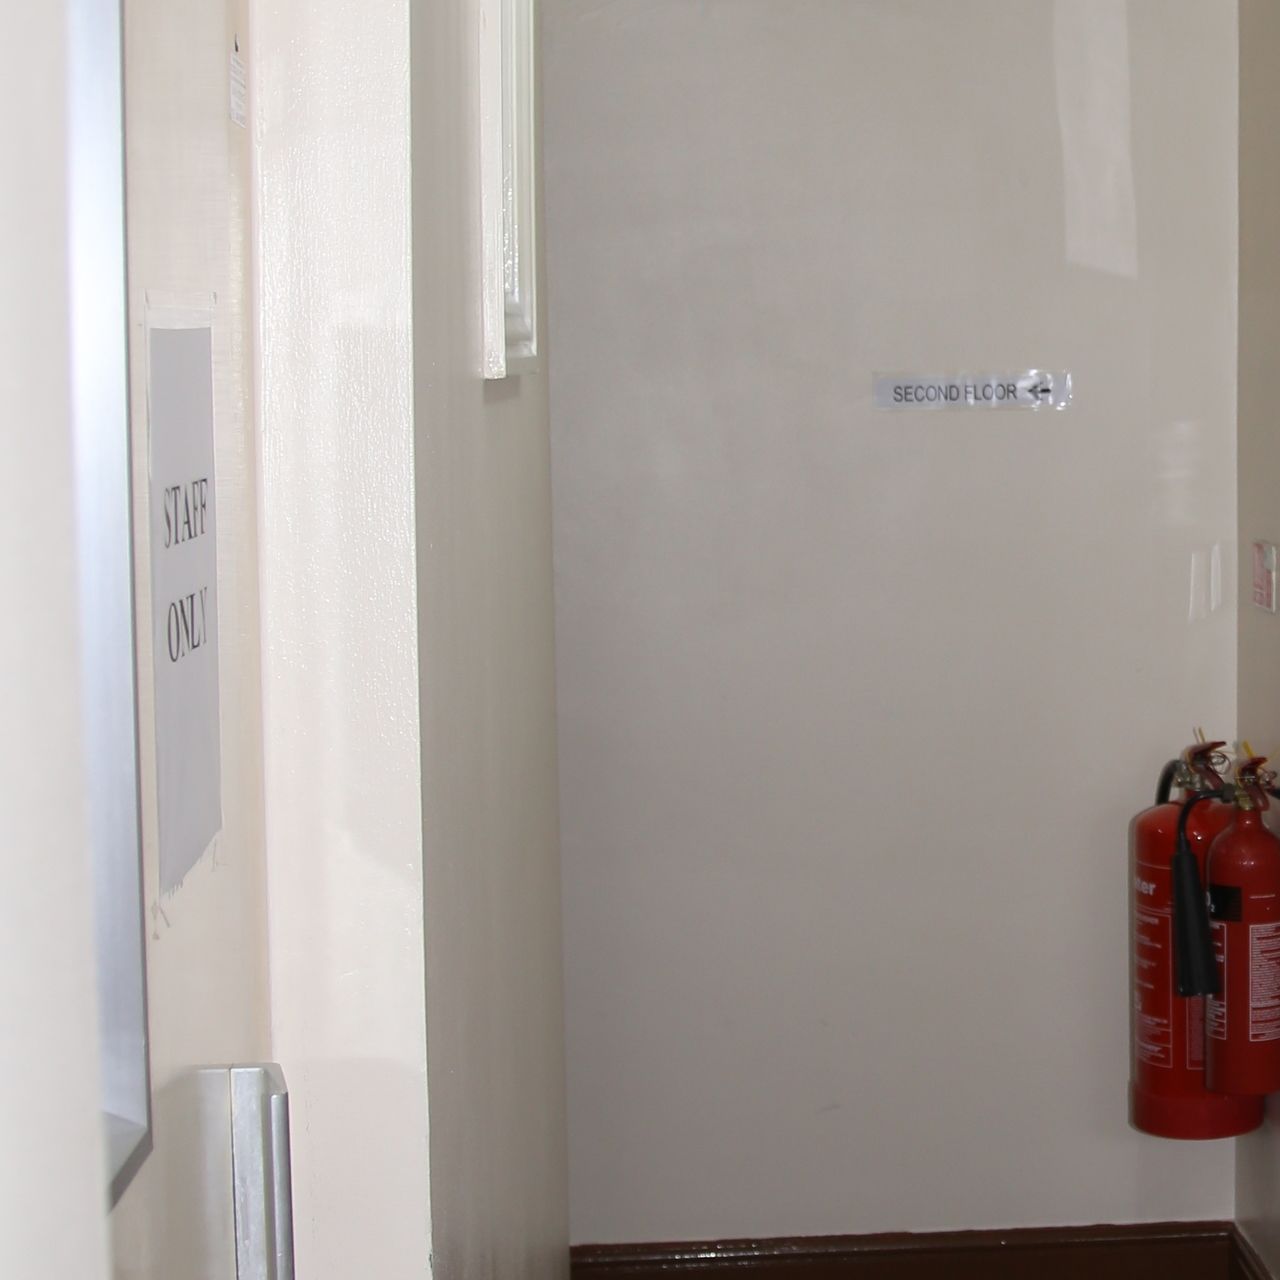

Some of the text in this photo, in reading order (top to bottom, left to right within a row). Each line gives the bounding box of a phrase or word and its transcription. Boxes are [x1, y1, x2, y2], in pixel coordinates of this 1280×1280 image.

[893, 383, 1018, 402] SECOND FLOOR
[164, 478, 208, 549] STAFF
[167, 587, 208, 663] ONLY
